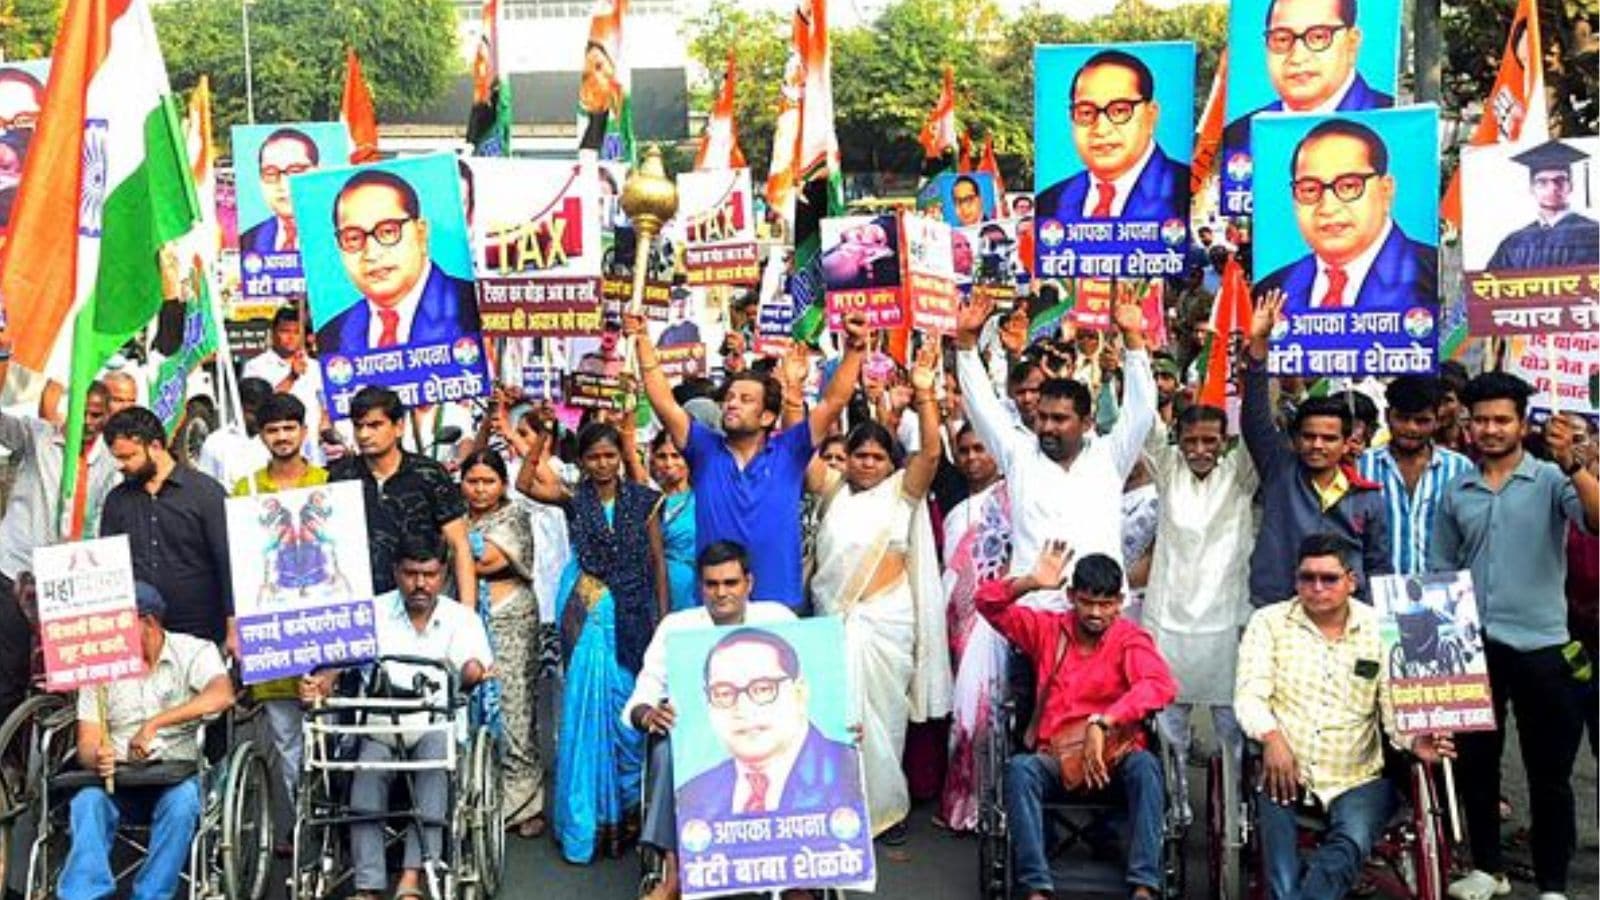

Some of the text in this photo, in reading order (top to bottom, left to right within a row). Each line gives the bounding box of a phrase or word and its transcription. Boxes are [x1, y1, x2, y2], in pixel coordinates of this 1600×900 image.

[1225, 186, 1253, 212] बंट
[690, 203, 738, 245] TAX
[1066, 222, 1159, 241] आपका अपना
[489, 217, 569, 275] TAX
[1040, 247, 1185, 276] बंटी बाबा शेळके
[833, 292, 865, 310] RTO
[1472, 272, 1582, 300] रोजगार
[1292, 312, 1400, 335] आपका अपना
[1491, 305, 1563, 328] न्याय
[354, 344, 451, 376] आपका अपना
[1307, 350, 1359, 373] बाबा
[1364, 341, 1434, 374] शेळके
[423, 369, 483, 402] शेळके
[714, 813, 826, 844] आपका अपना
[685, 844, 863, 888] बंटी बाबा शेळके
